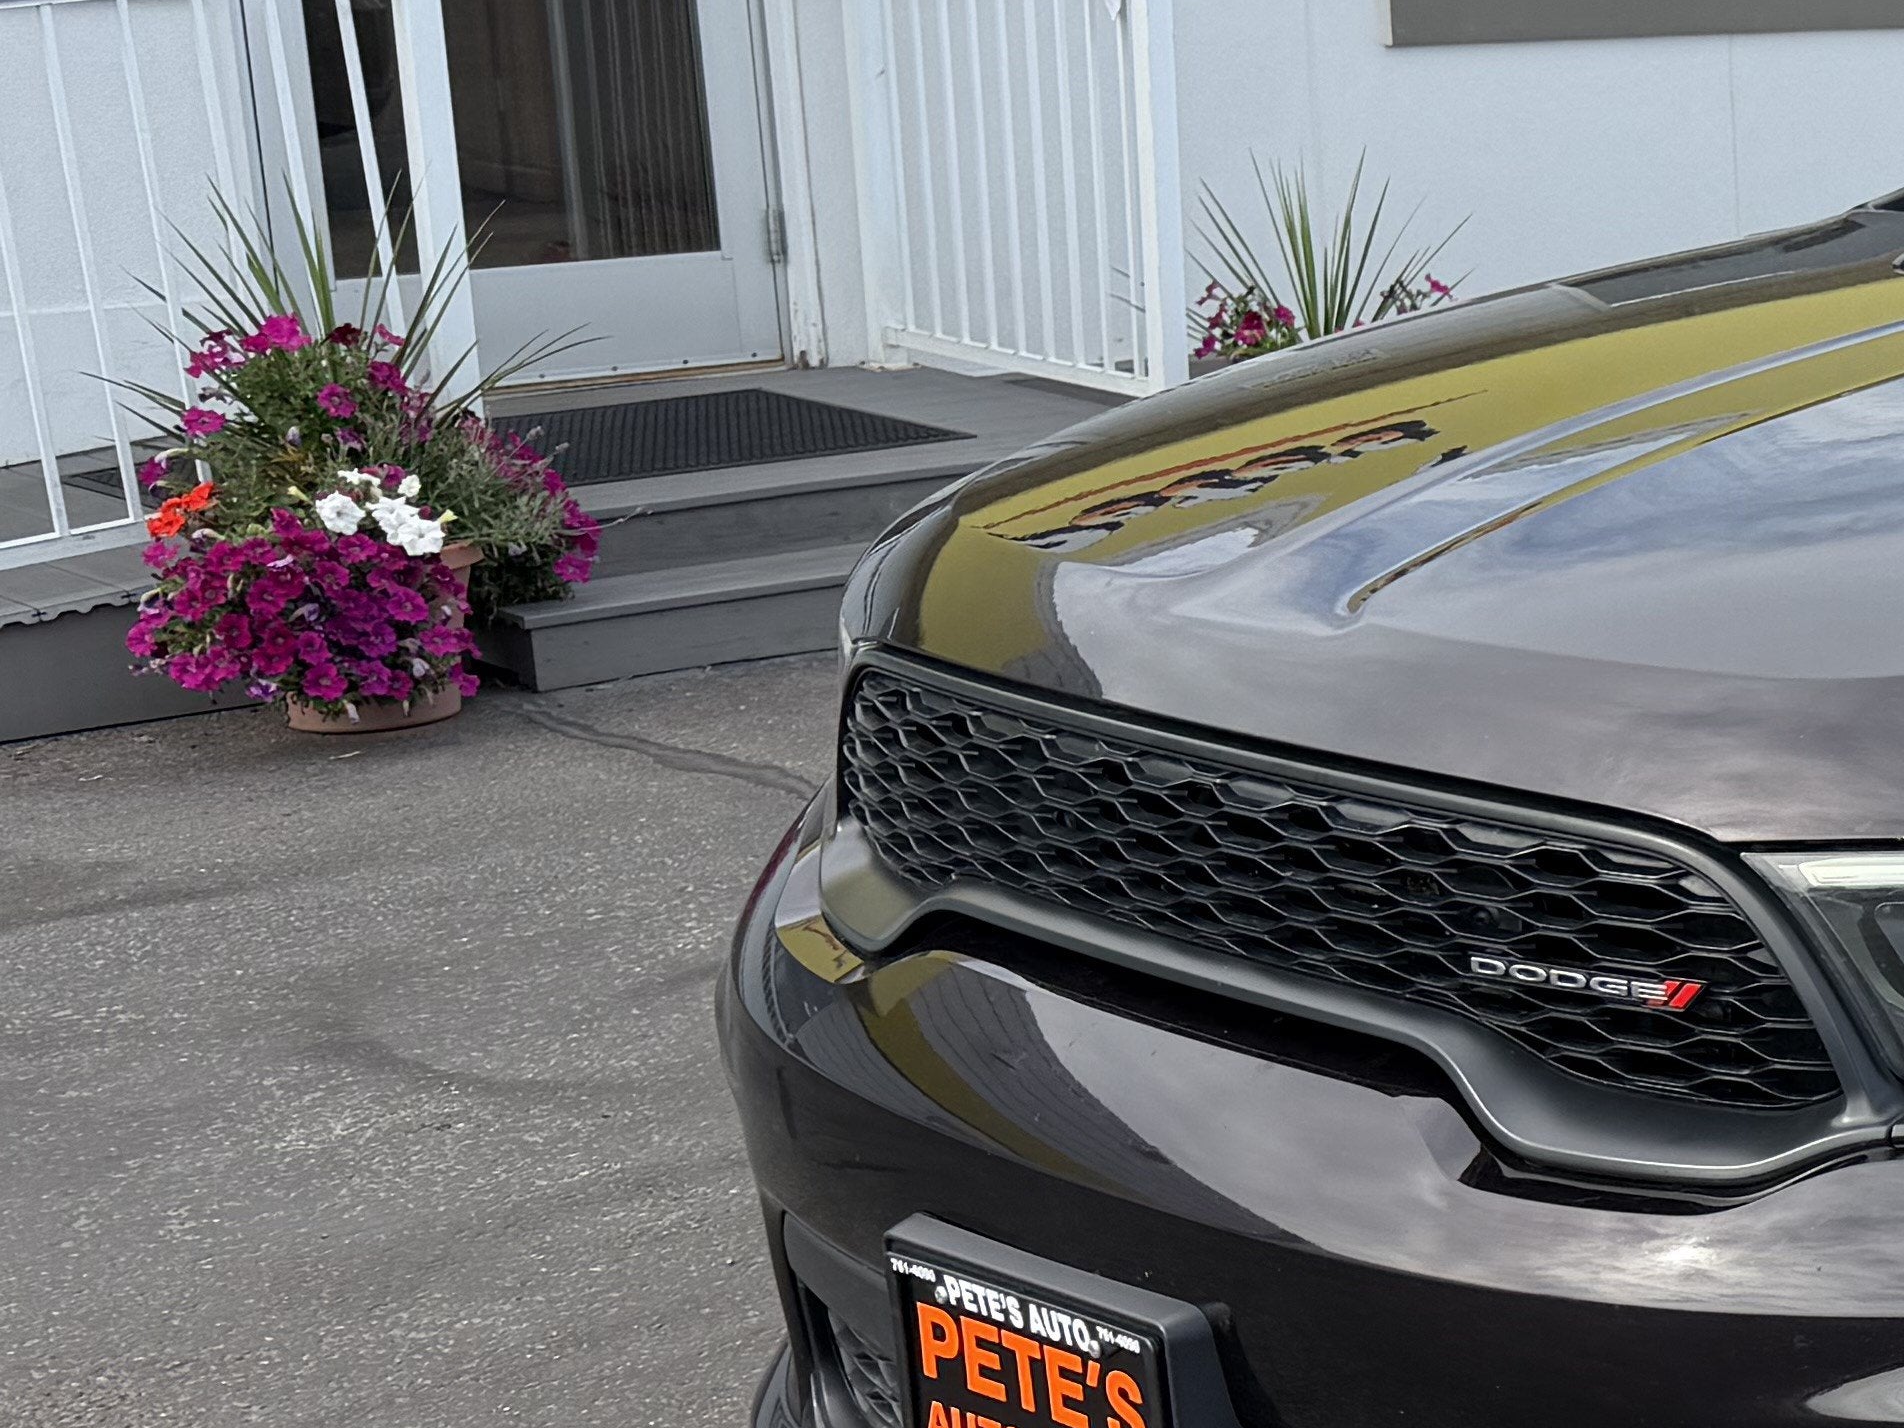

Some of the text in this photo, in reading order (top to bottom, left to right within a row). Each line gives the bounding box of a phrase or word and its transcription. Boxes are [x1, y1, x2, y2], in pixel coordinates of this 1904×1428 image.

[1470, 956, 1669, 1002] DODGE
[943, 1274, 1024, 1329] PETE'S
[1028, 1302, 1091, 1352] AUTO
